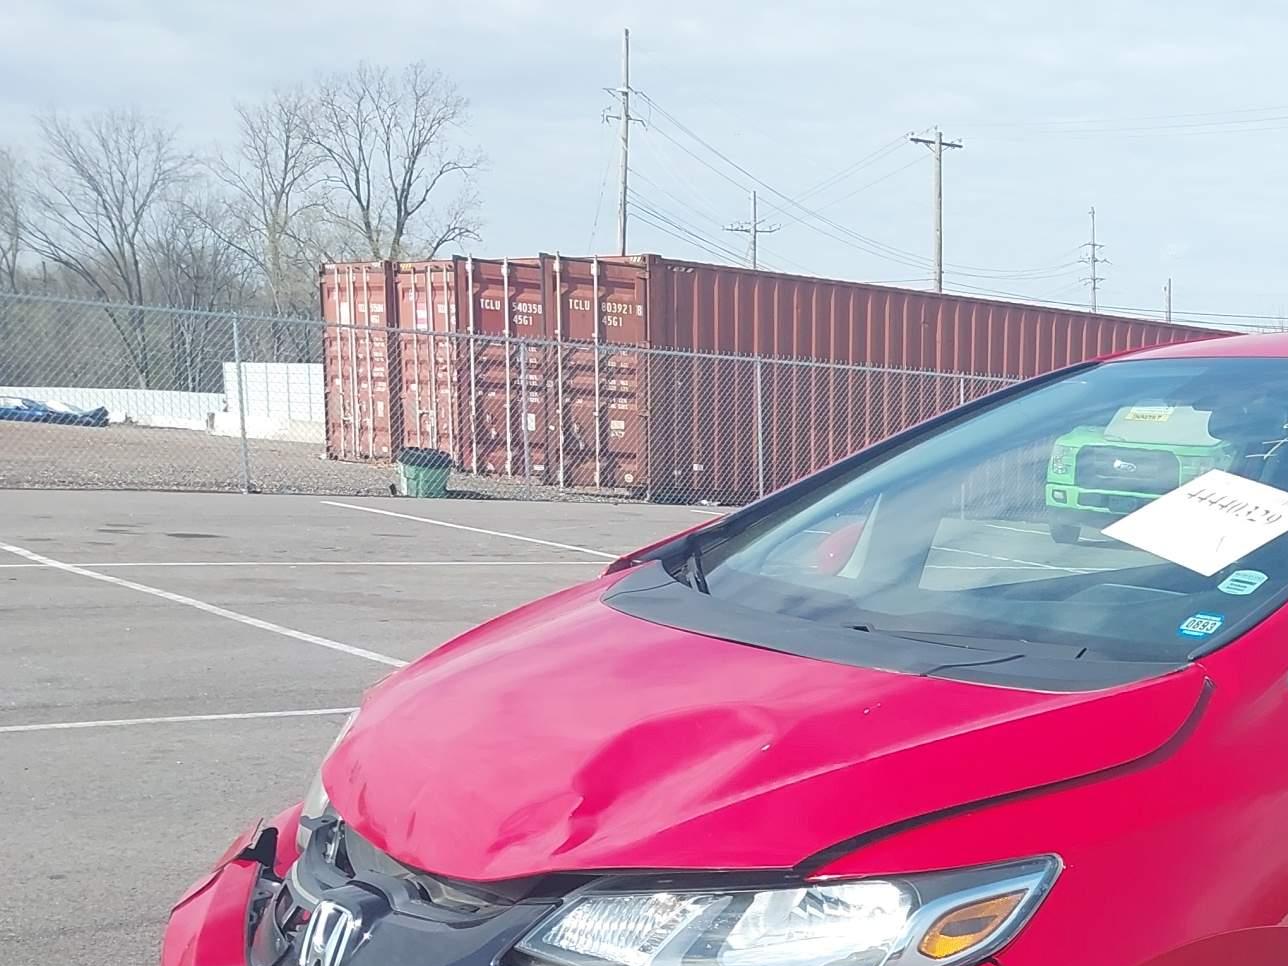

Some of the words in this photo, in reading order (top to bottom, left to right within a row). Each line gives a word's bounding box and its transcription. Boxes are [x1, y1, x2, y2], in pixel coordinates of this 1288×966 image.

[480, 298, 501, 311] TCLU
[568, 298, 591, 311] TCLU
[601, 302, 633, 315] 803921
[512, 314, 533, 326] 45G1
[601, 315, 623, 327] 45G1
